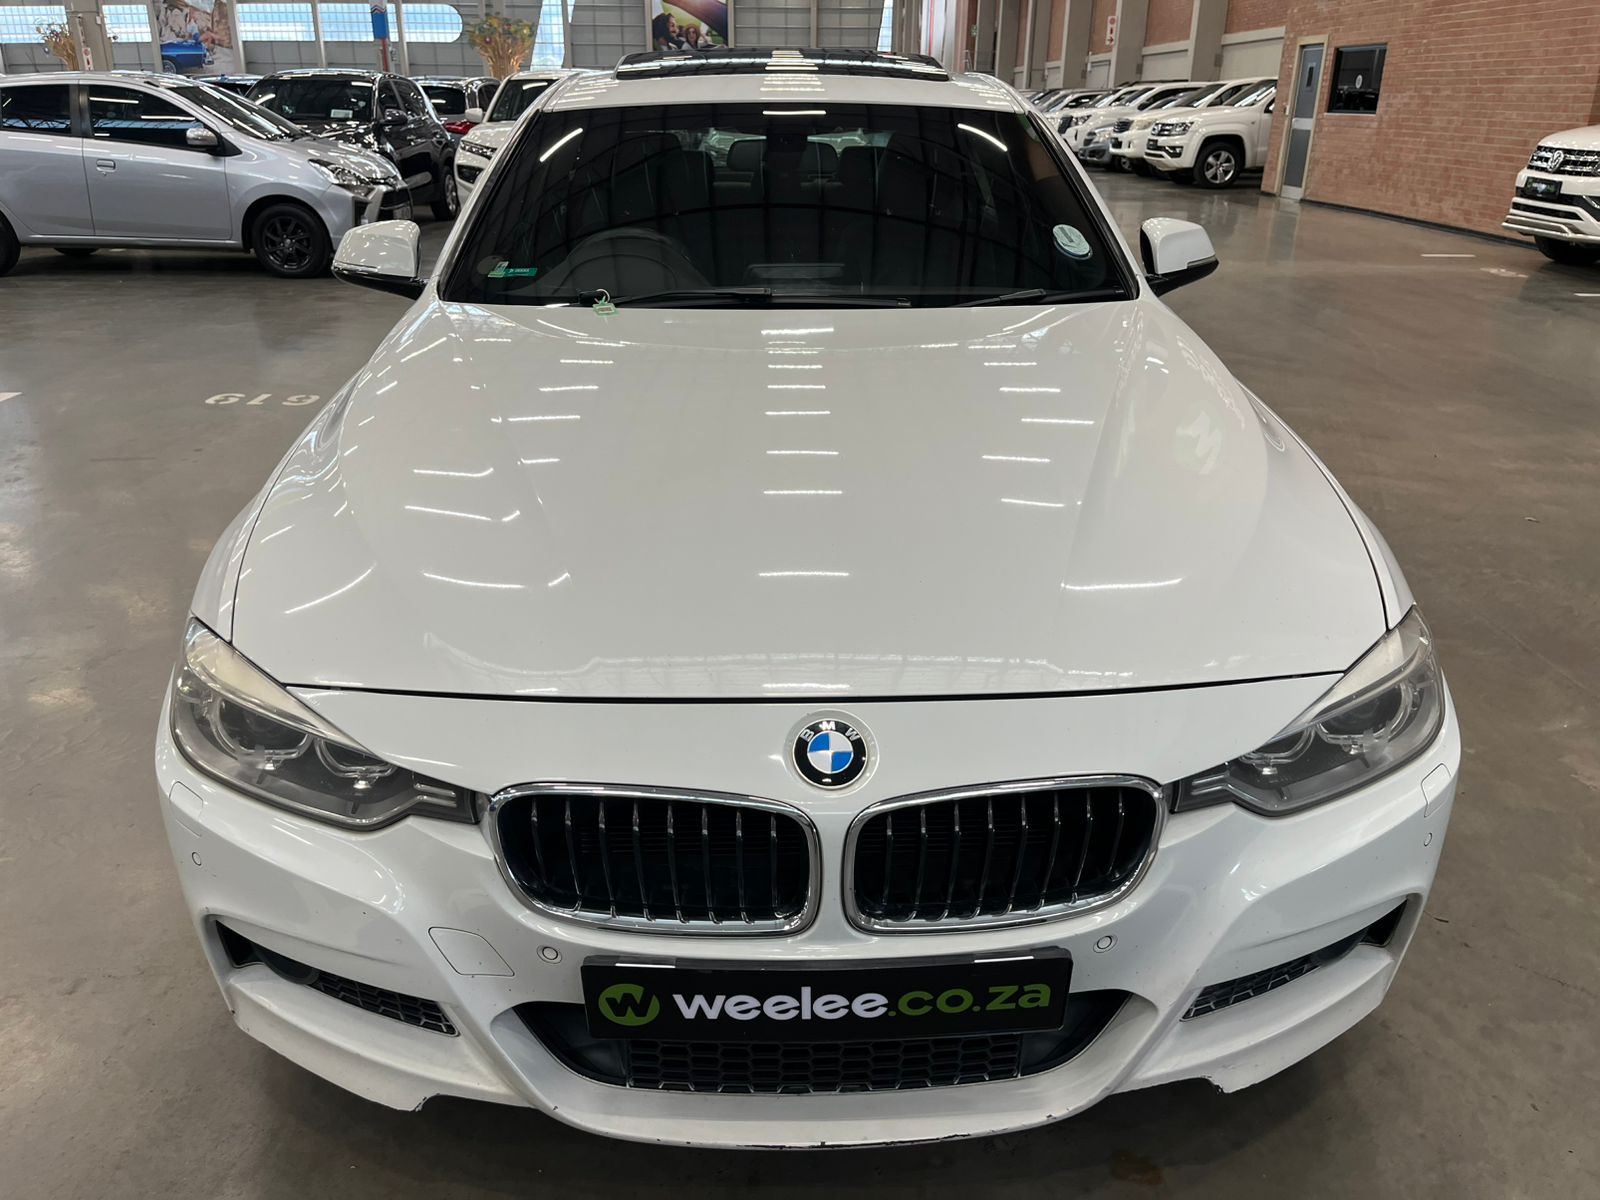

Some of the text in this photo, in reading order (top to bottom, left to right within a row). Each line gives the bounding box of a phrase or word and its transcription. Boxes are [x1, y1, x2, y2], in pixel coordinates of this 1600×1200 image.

[205, 393, 320, 406] 619
[800, 720, 861, 742] BMW
[672, 983, 1051, 1021] weelee.co.za
